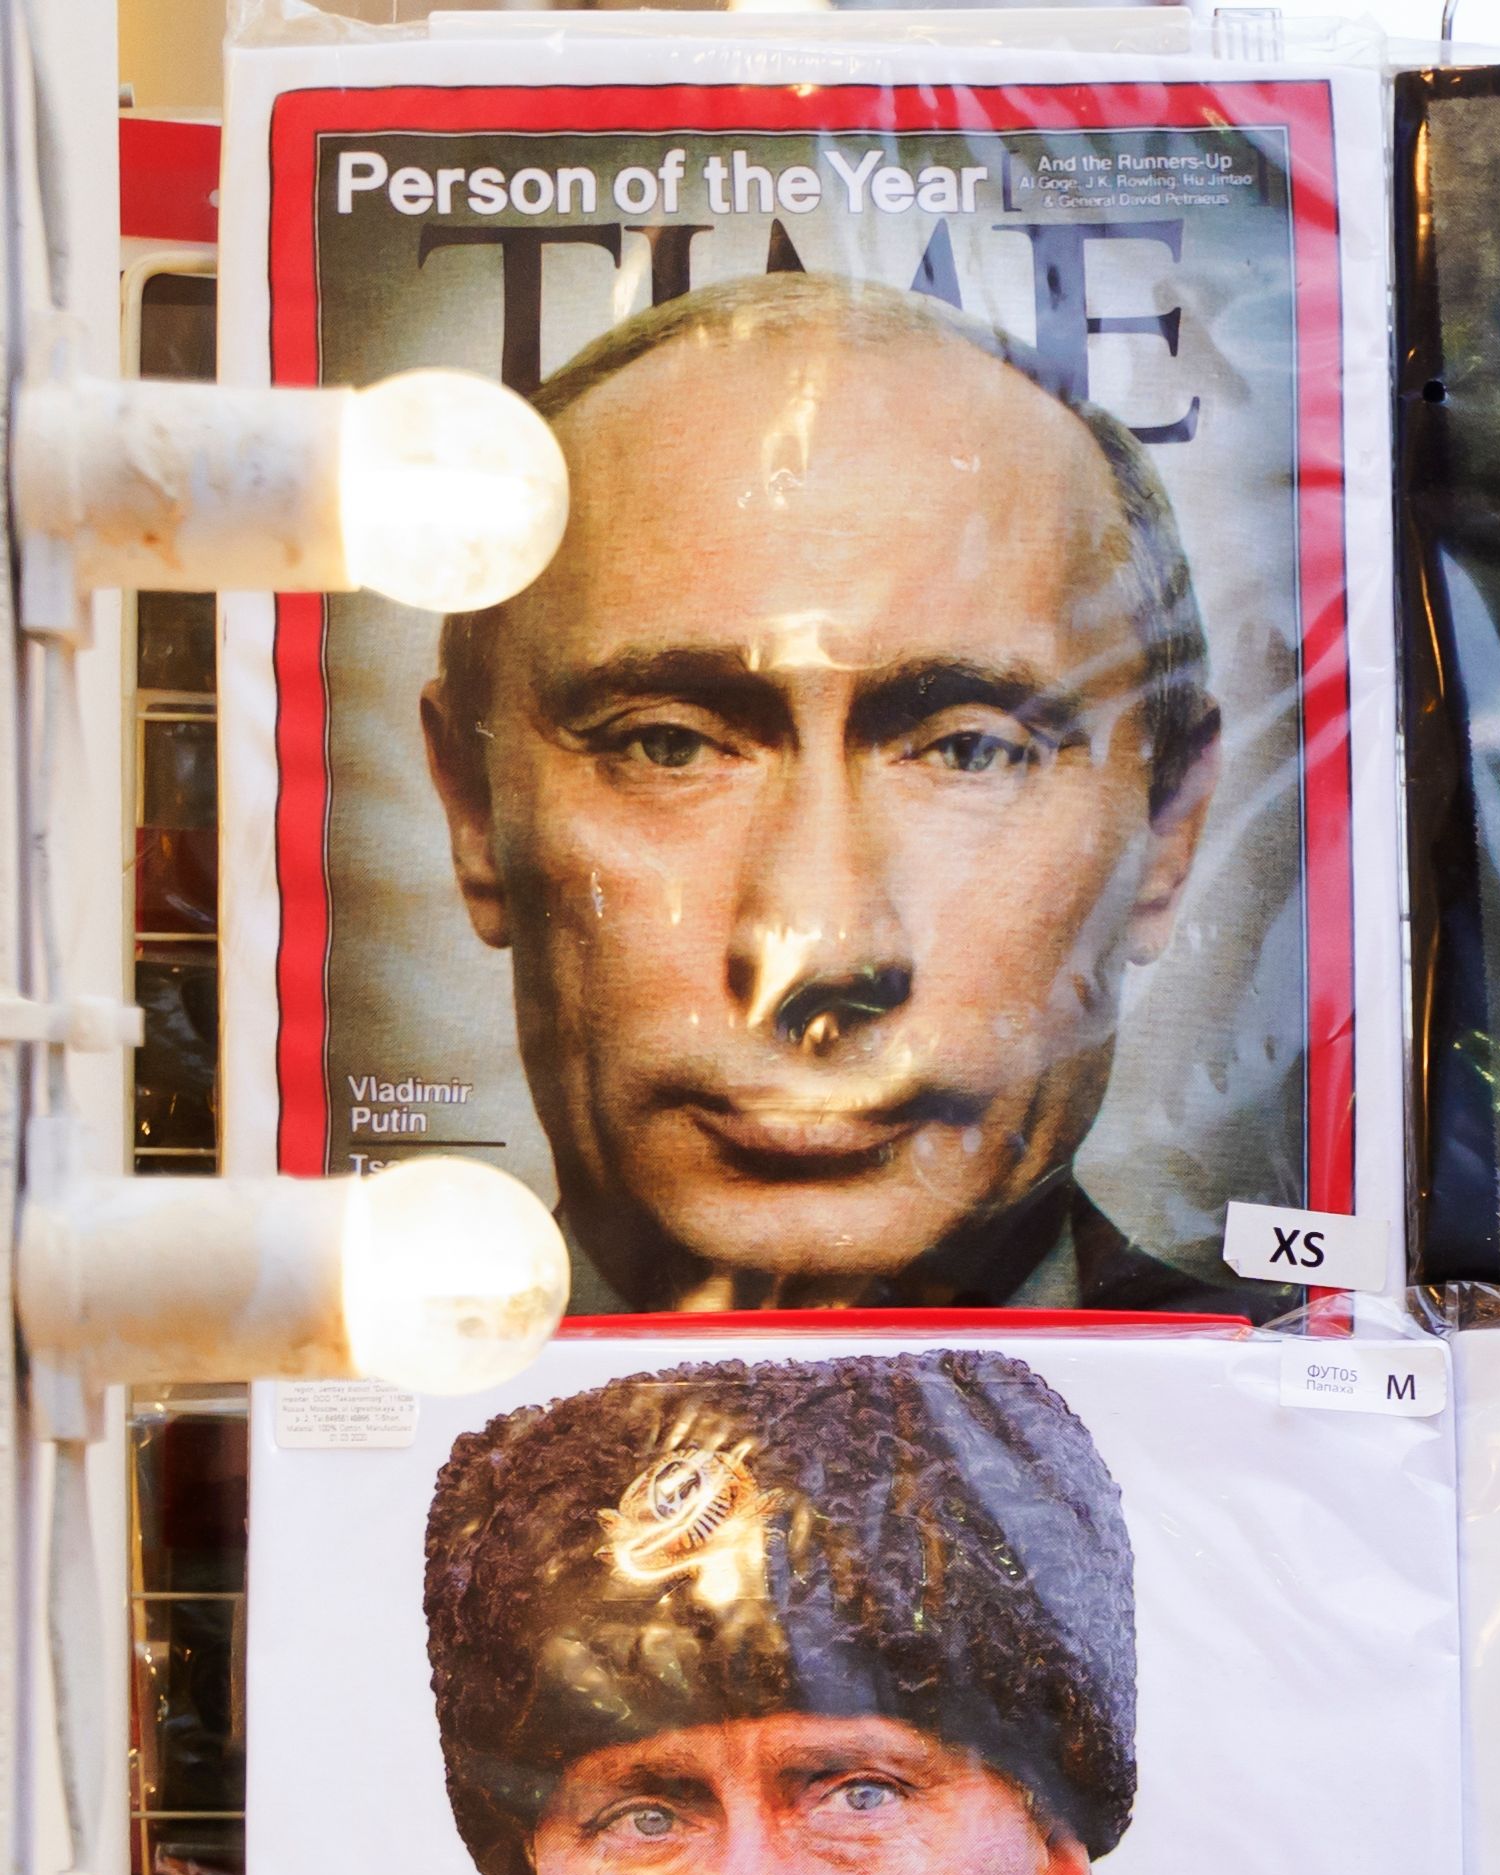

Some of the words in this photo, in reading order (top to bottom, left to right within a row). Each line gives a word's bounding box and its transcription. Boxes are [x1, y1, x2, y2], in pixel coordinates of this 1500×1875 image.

[1038, 156, 1077, 172] And
[1083, 154, 1112, 171] the
[1118, 152, 1233, 173] Runners-Up
[336, 151, 597, 216] Person
[612, 148, 687, 217] of
[704, 150, 822, 216] the
[824, 150, 988, 216] Year
[348, 1075, 473, 1104] Vladimir
[351, 1106, 428, 1134] Putin
[1269, 1227, 1325, 1268] XS
[1307, 1364, 1357, 1382] ФУТ05
[1306, 1380, 1354, 1394] Папаха
[1387, 1374, 1415, 1400] M
